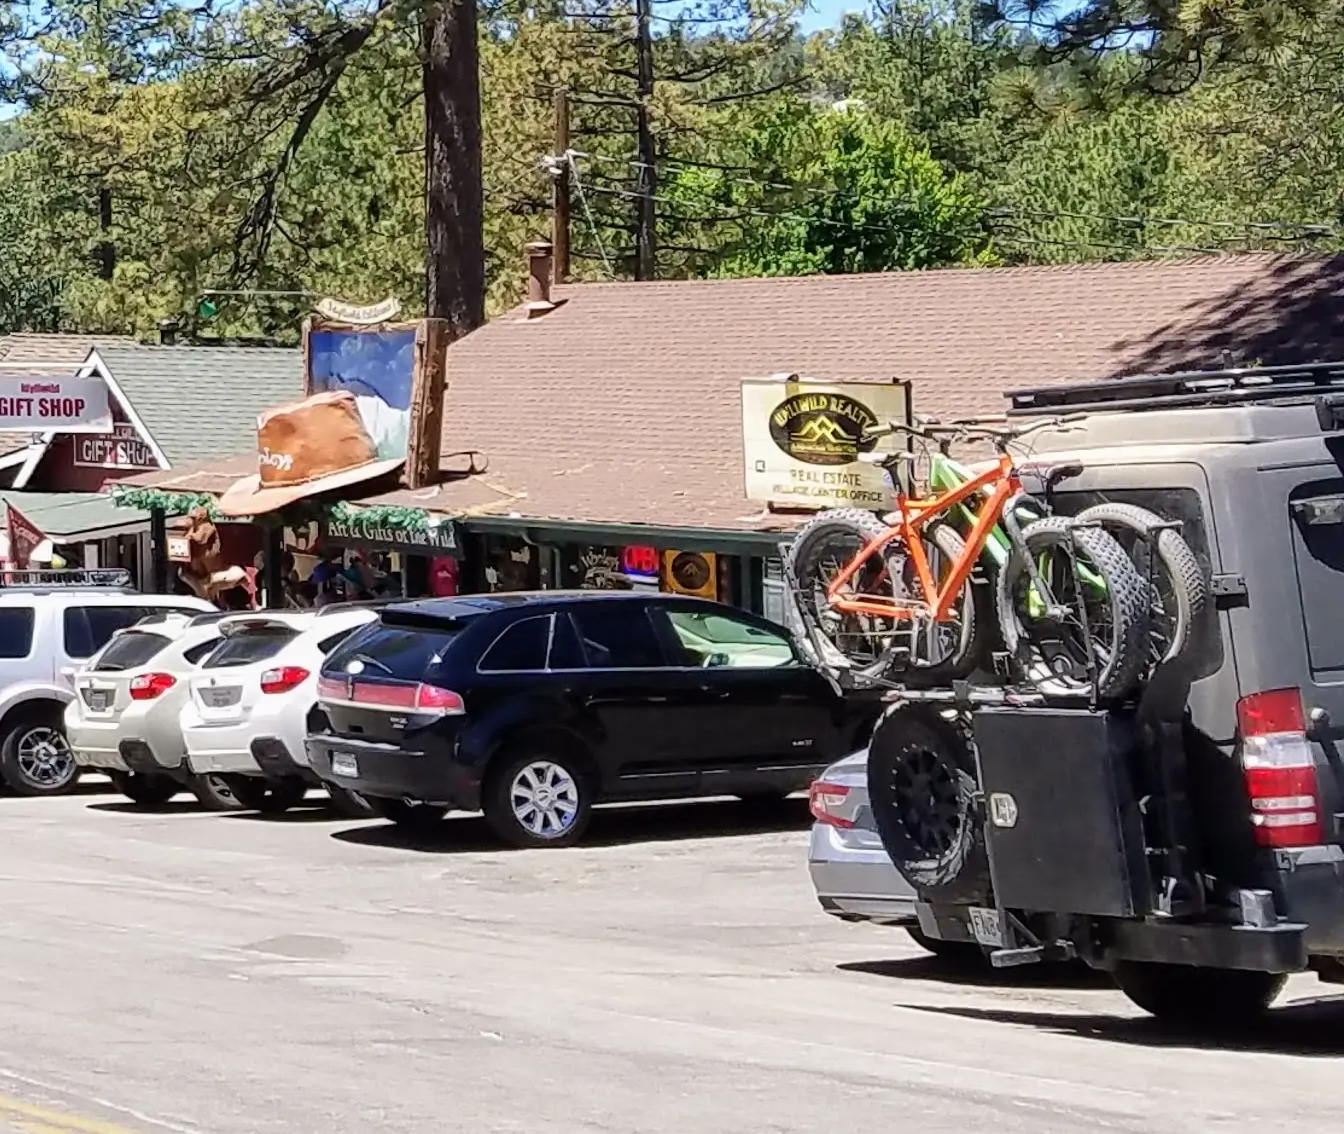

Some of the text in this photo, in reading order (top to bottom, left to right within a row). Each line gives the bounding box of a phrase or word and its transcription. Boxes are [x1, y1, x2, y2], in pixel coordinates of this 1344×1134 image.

[39, 398, 85, 417] SHOP
[830, 397, 874, 428] REALTY
[82, 440, 114, 463] GIFT
[790, 469, 862, 486] REAL ESTATE
[850, 489, 883, 502] OFFICE
